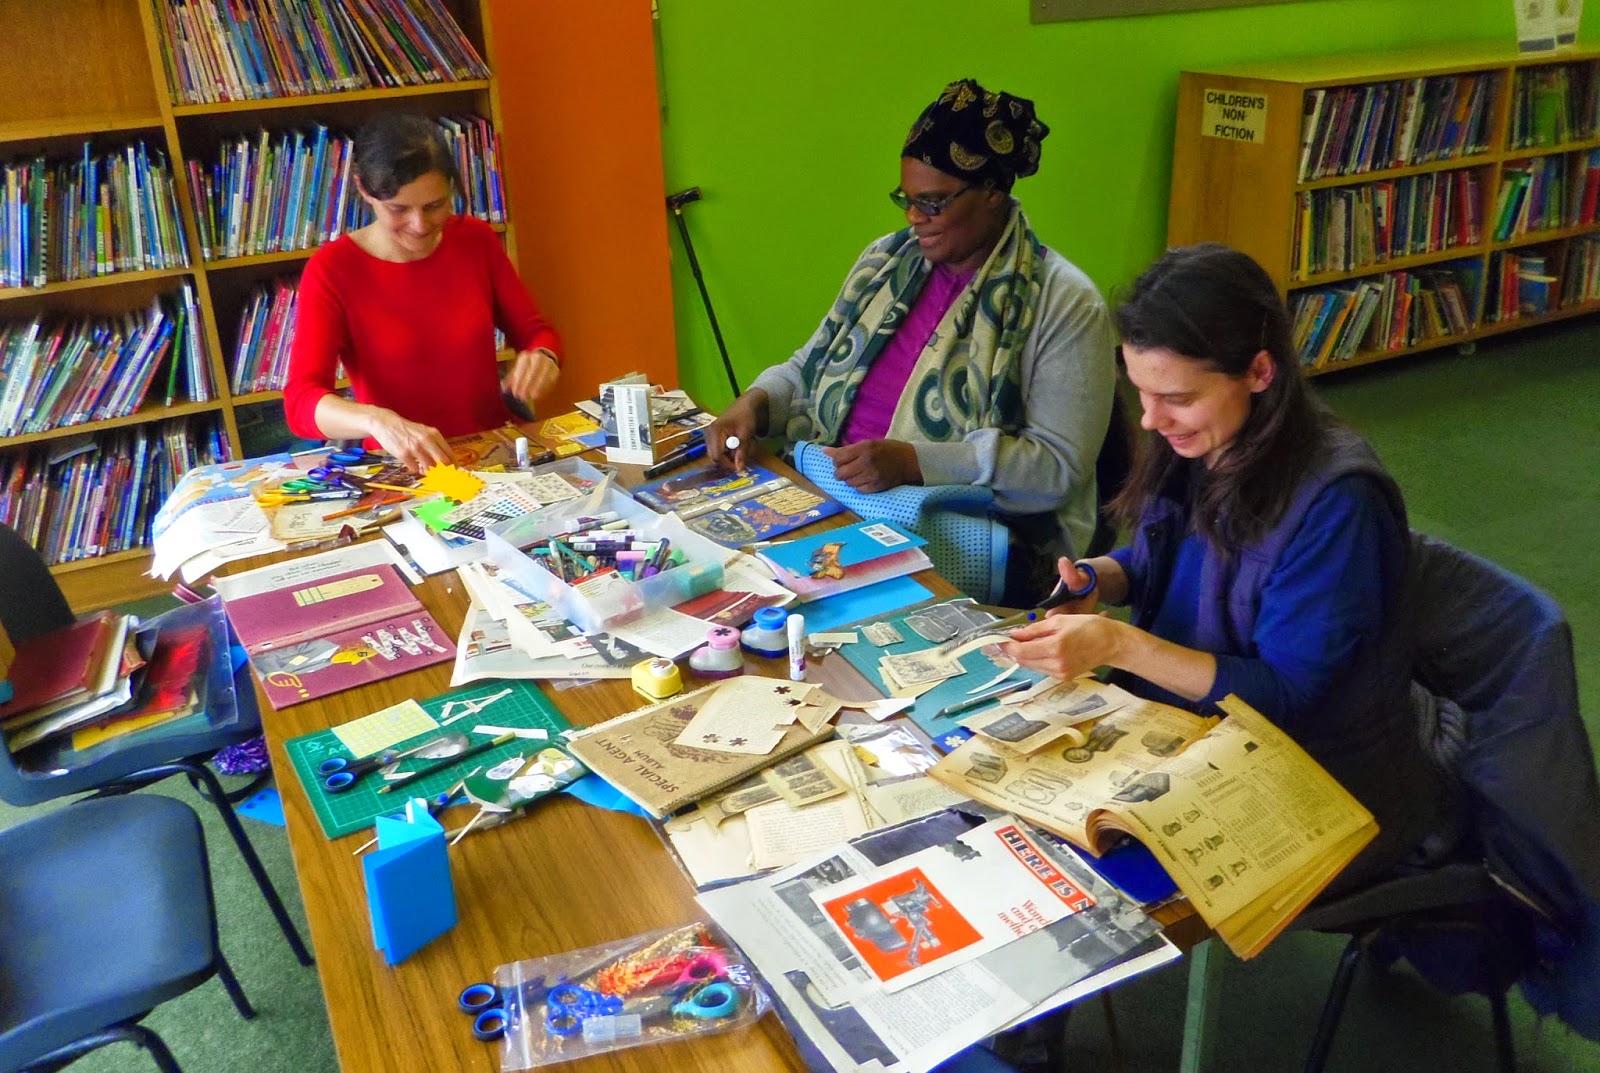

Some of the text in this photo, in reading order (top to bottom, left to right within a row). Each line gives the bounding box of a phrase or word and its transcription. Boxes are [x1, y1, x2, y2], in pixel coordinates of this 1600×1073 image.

[1206, 92, 1264, 109] CHILDREN'S
[1215, 124, 1255, 142] FICTION
[595, 738, 636, 764] AGENT
[633, 749, 666, 770] ALBUM
[634, 764, 680, 793] SPECIAL
[1002, 829, 1057, 880] HERE
[1050, 879, 1077, 898] IS
